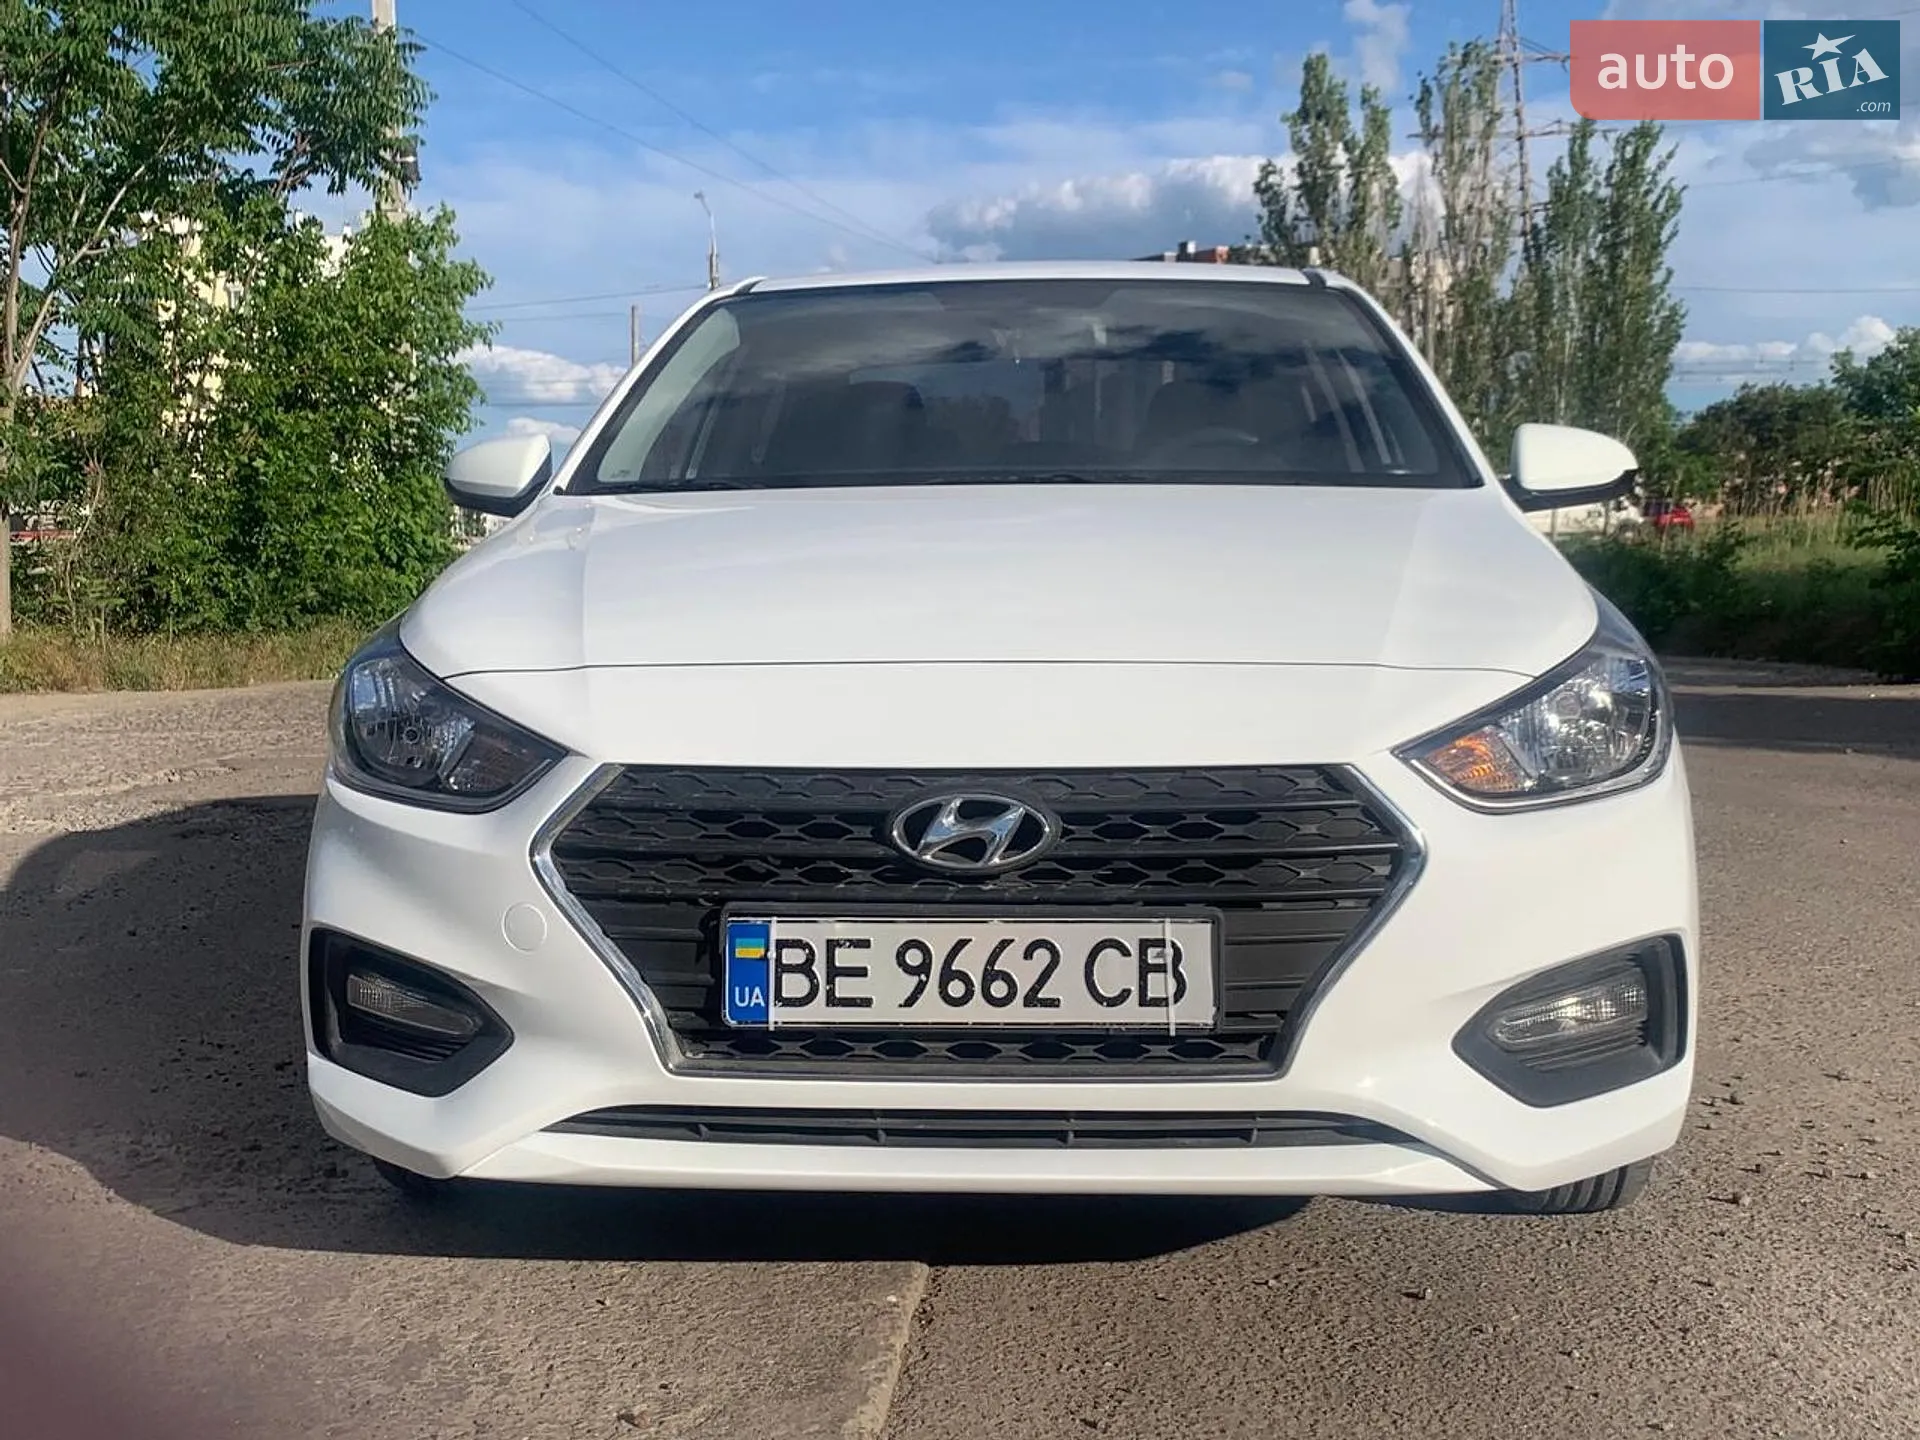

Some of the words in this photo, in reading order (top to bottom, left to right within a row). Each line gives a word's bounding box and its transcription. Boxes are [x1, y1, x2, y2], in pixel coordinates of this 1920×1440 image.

[774, 938, 873, 1008] BE
[896, 938, 1062, 1008] 9662
[1085, 938, 1188, 1008] CB
[735, 987, 765, 1008] UA
